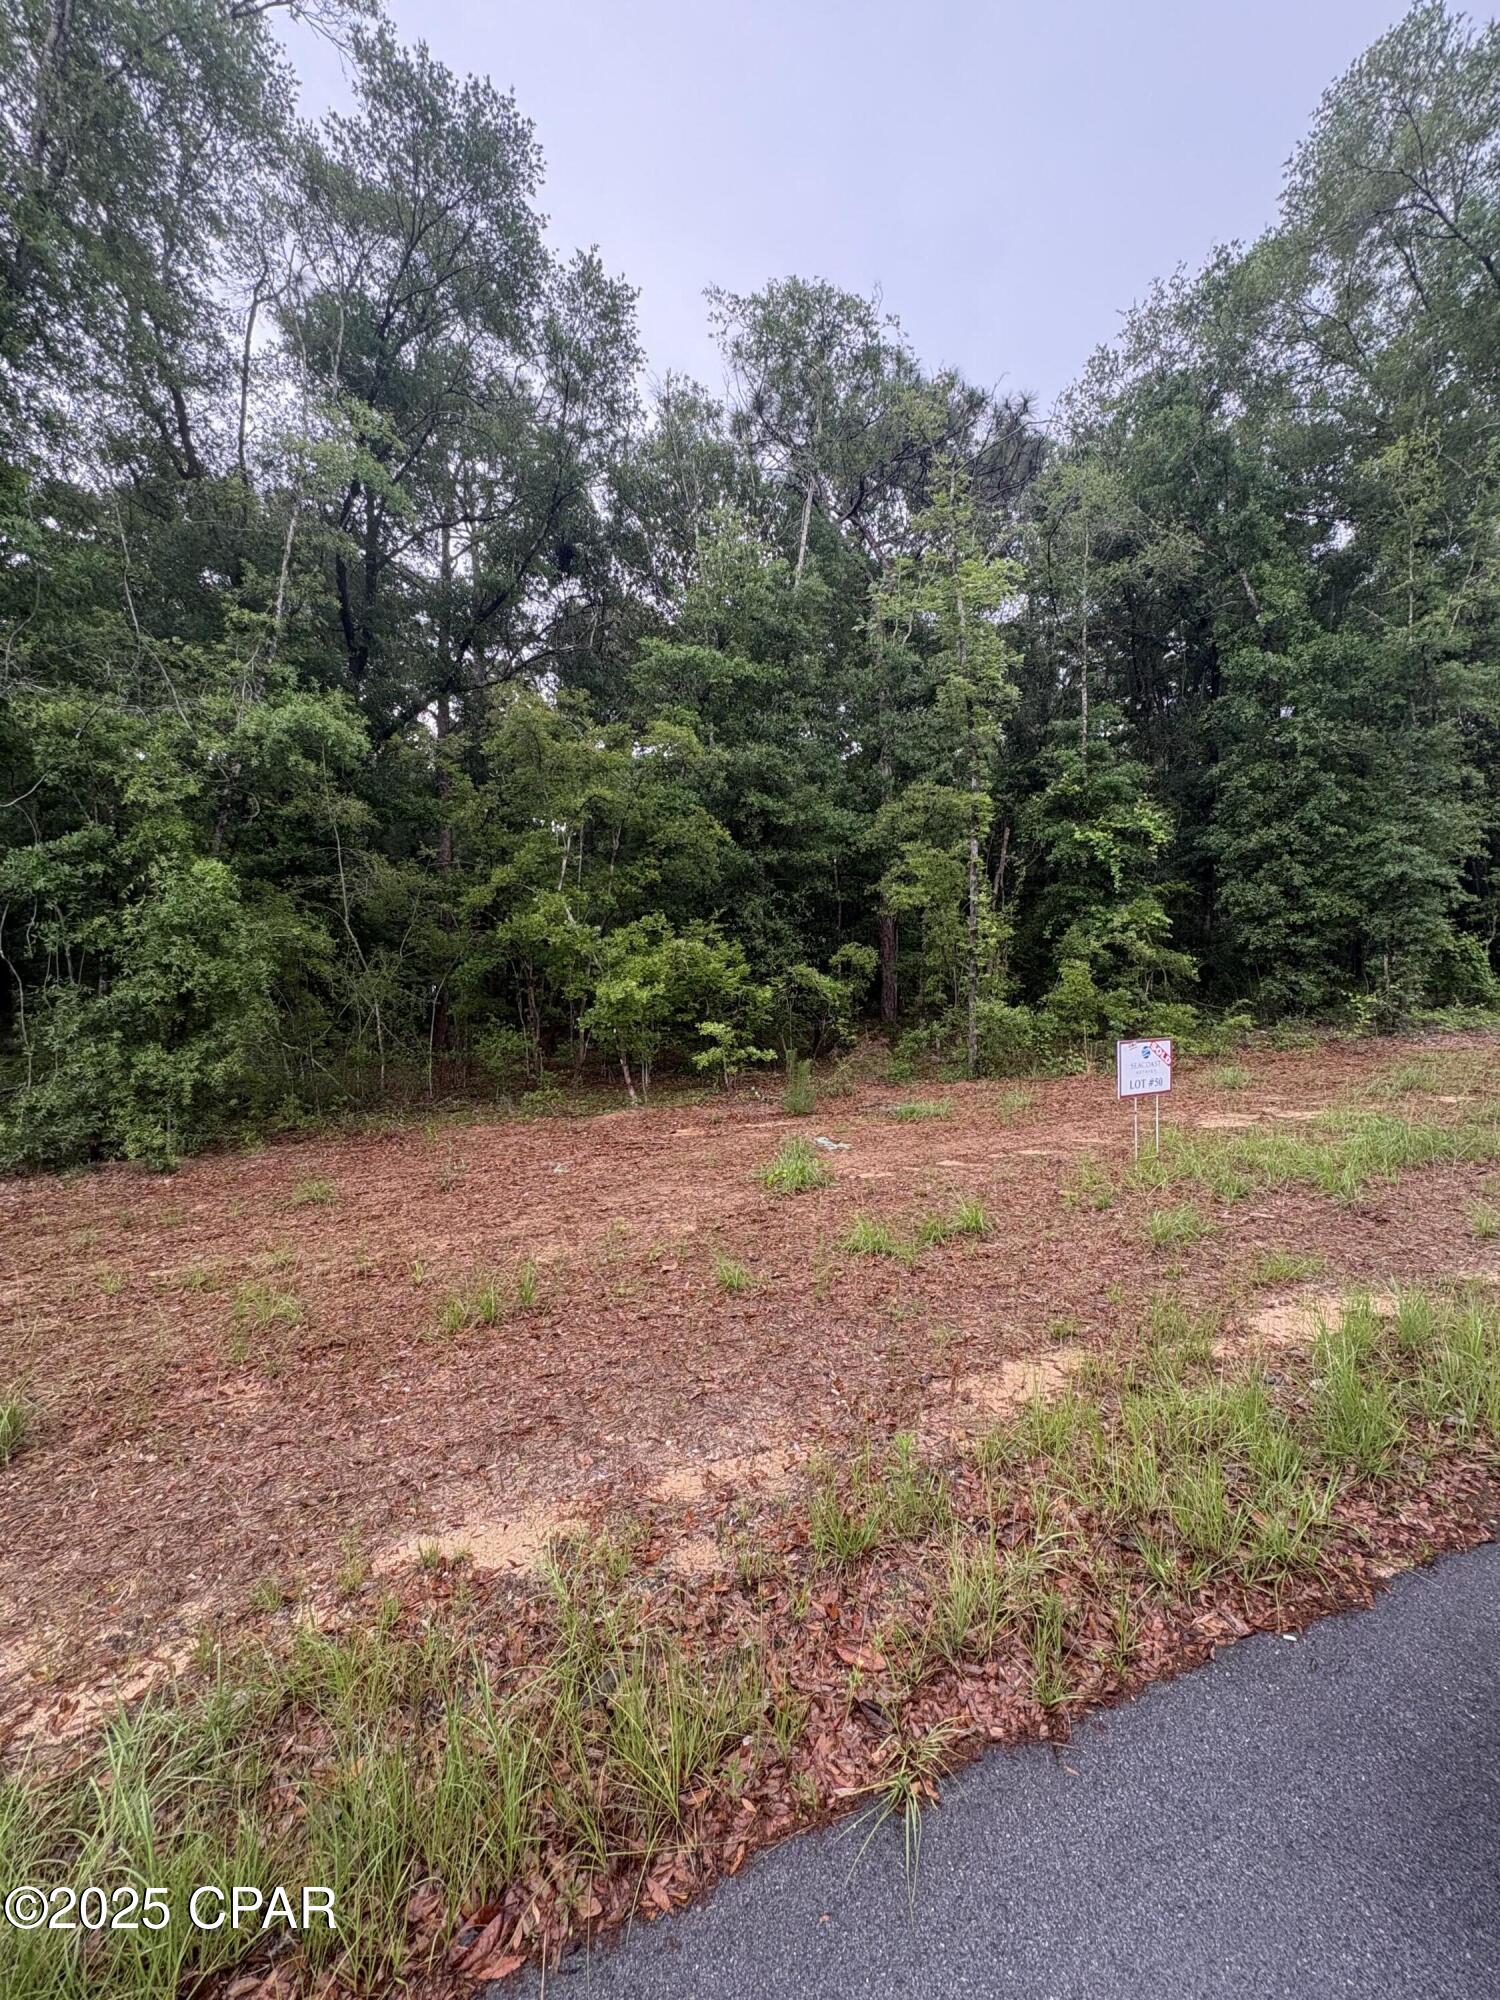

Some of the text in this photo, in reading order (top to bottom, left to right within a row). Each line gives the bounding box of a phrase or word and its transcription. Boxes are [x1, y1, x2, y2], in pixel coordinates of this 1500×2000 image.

[1150, 1041, 1171, 1065] SOLD
[1129, 1077, 1163, 1089] LOT #50
